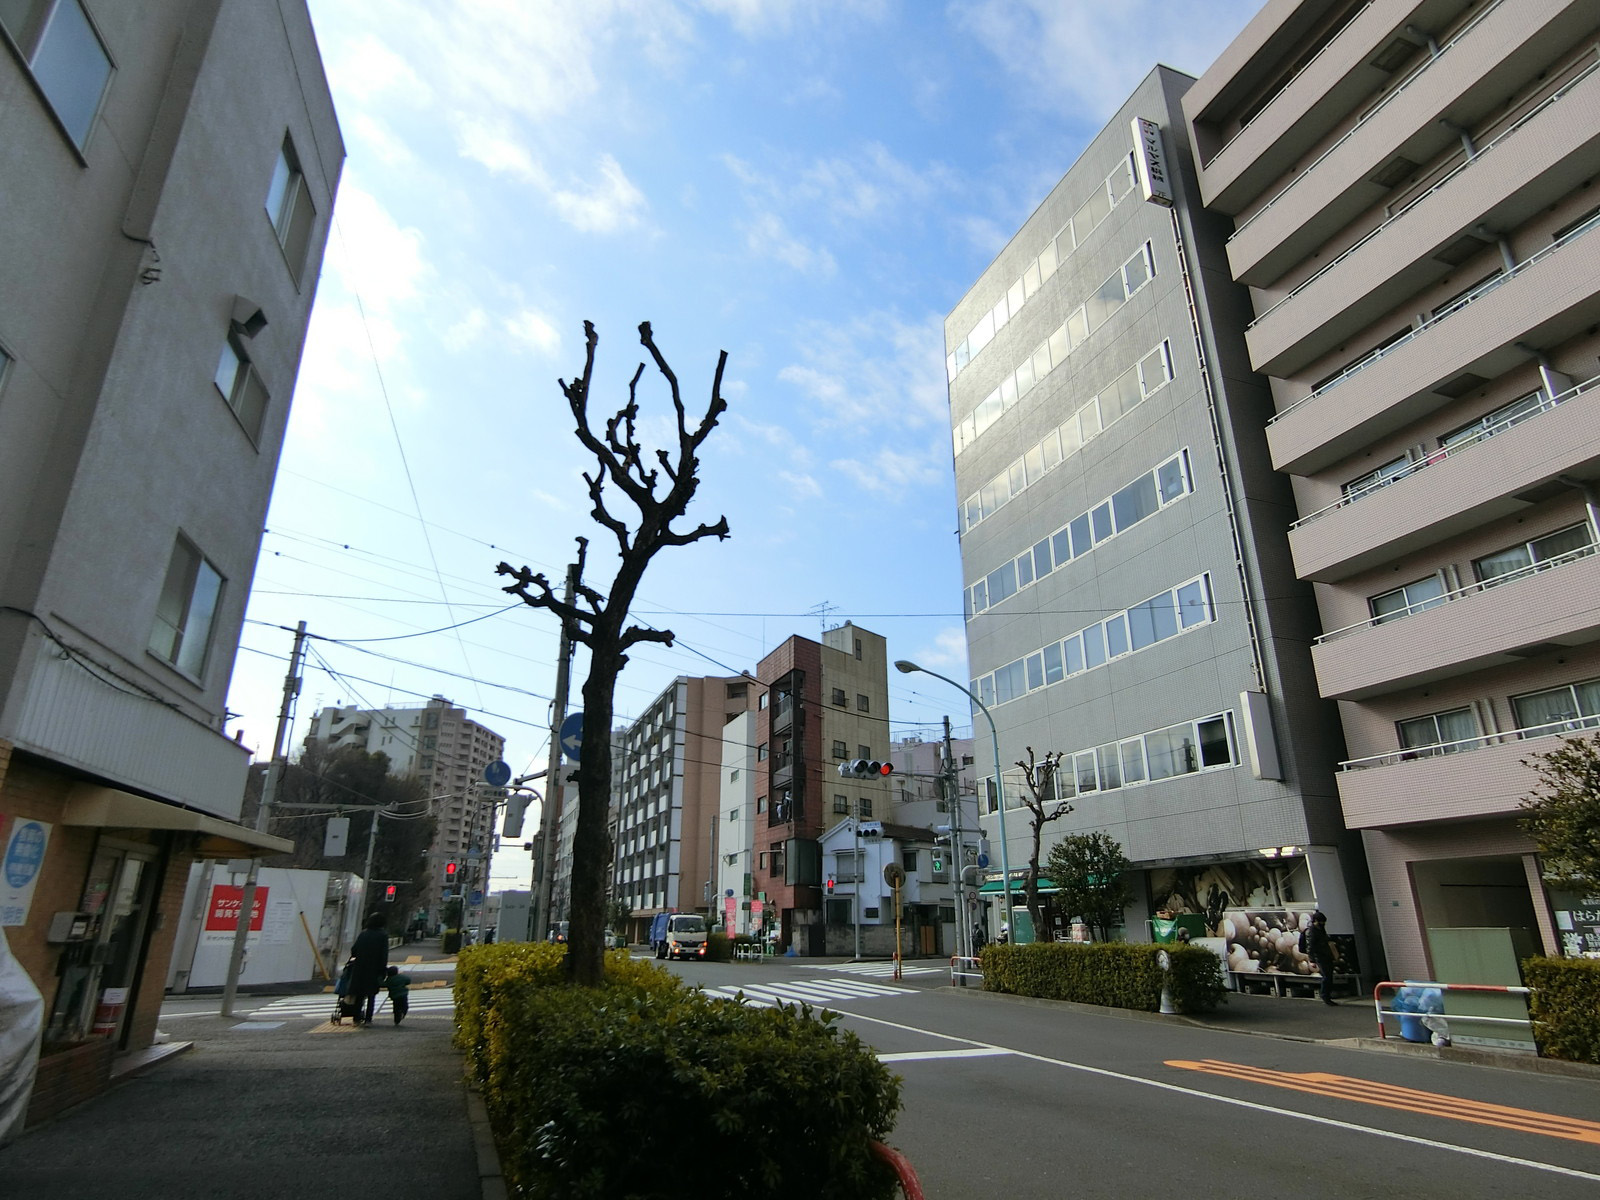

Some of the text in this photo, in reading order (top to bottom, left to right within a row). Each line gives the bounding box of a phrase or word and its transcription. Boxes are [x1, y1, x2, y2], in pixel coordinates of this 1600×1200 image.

[217, 899, 261, 908] サンケル
[214, 909, 259, 918] 開発予地
